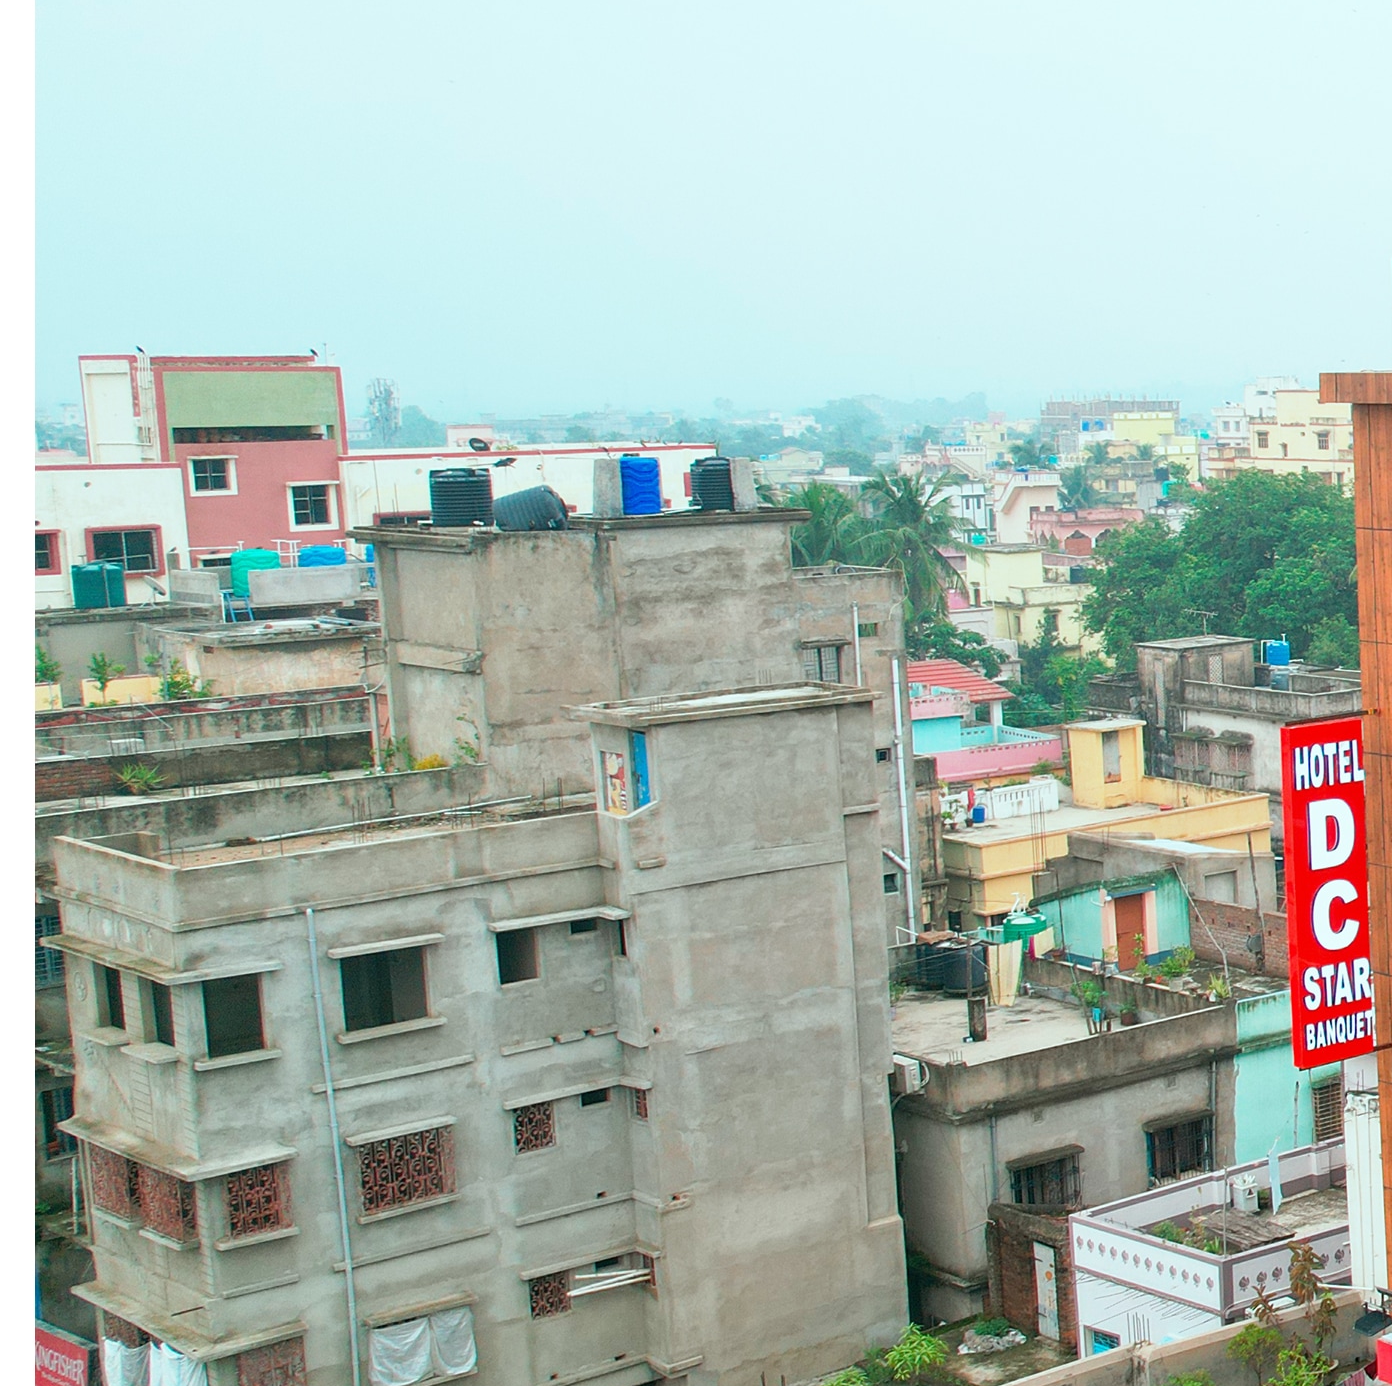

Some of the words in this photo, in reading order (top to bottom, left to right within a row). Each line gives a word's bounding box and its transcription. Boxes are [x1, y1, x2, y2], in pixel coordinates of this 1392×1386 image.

[1293, 739, 1365, 791] HOTEL
[1307, 797, 1356, 871] D
[1310, 878, 1360, 951] C
[1303, 957, 1372, 1012] STAR
[1304, 1009, 1375, 1051] BANQUET
